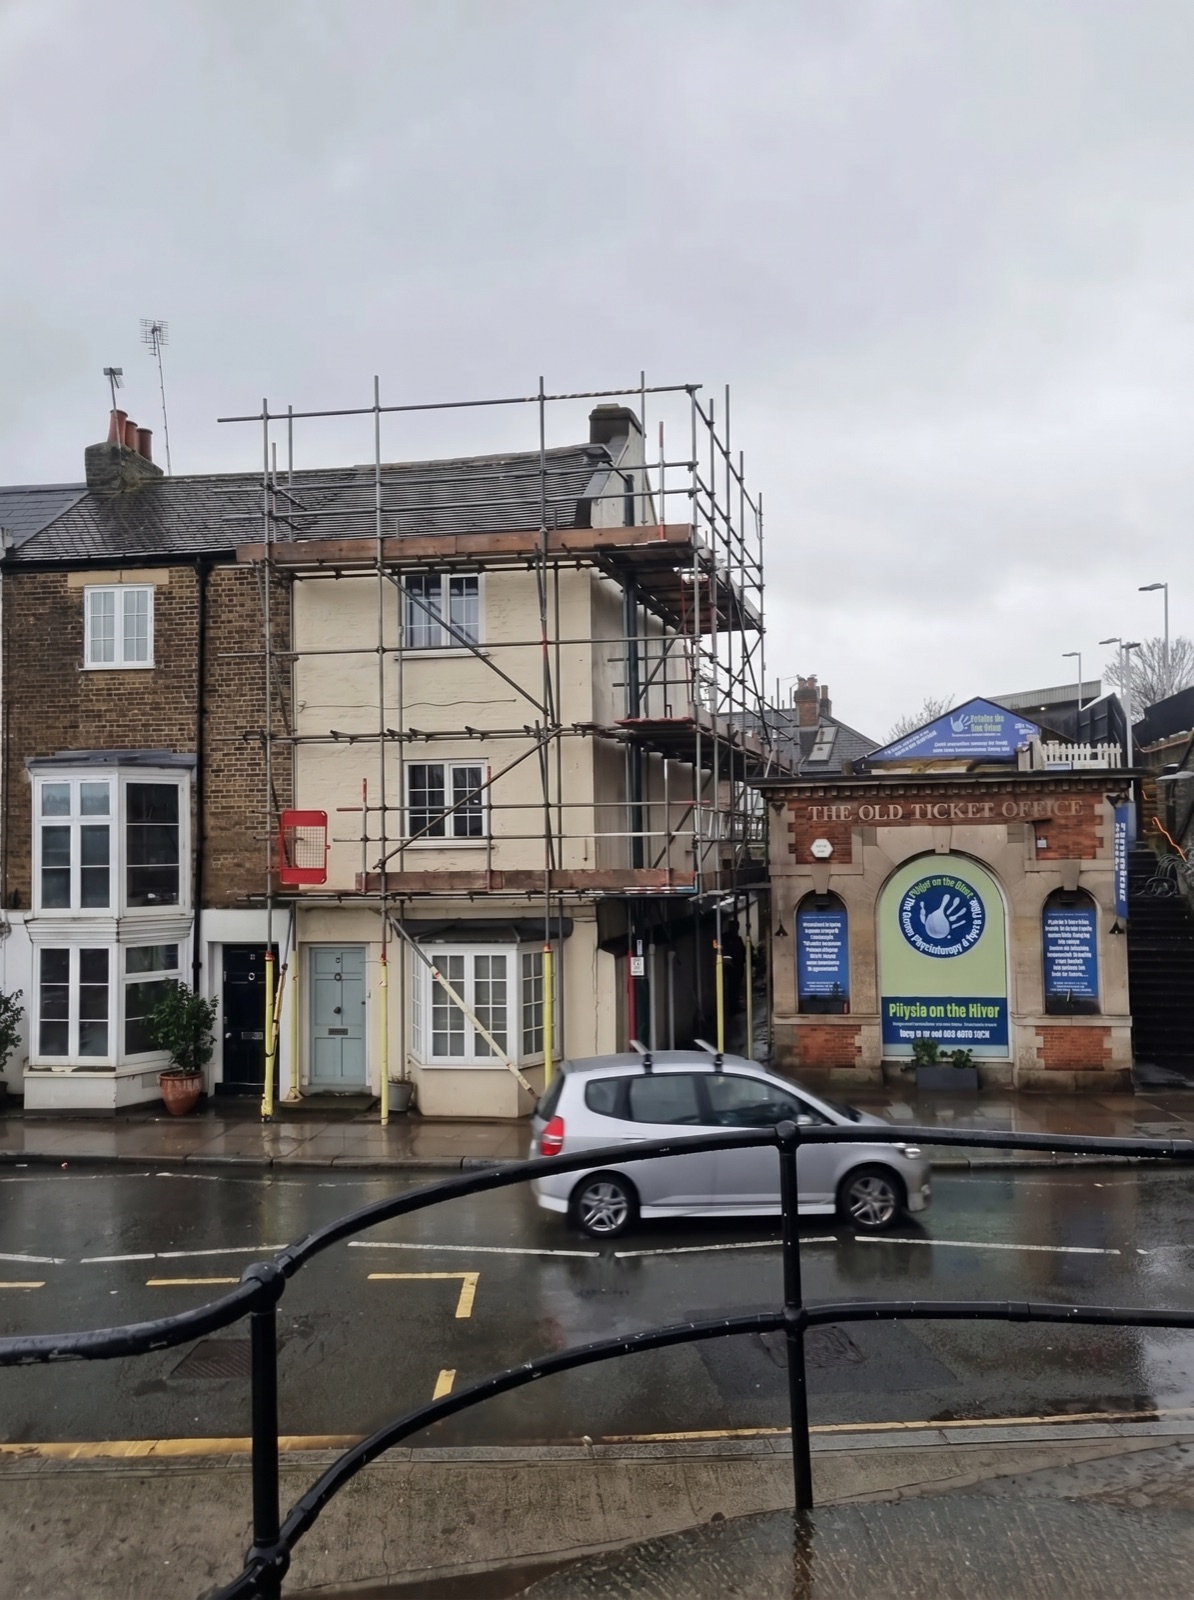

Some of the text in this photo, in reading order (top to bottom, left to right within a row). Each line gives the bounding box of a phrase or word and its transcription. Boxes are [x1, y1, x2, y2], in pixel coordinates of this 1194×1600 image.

[808, 800, 1084, 821] THE OLD TICKET OFFICE
[929, 1006, 945, 1018] on
[946, 1003, 966, 1018] the
